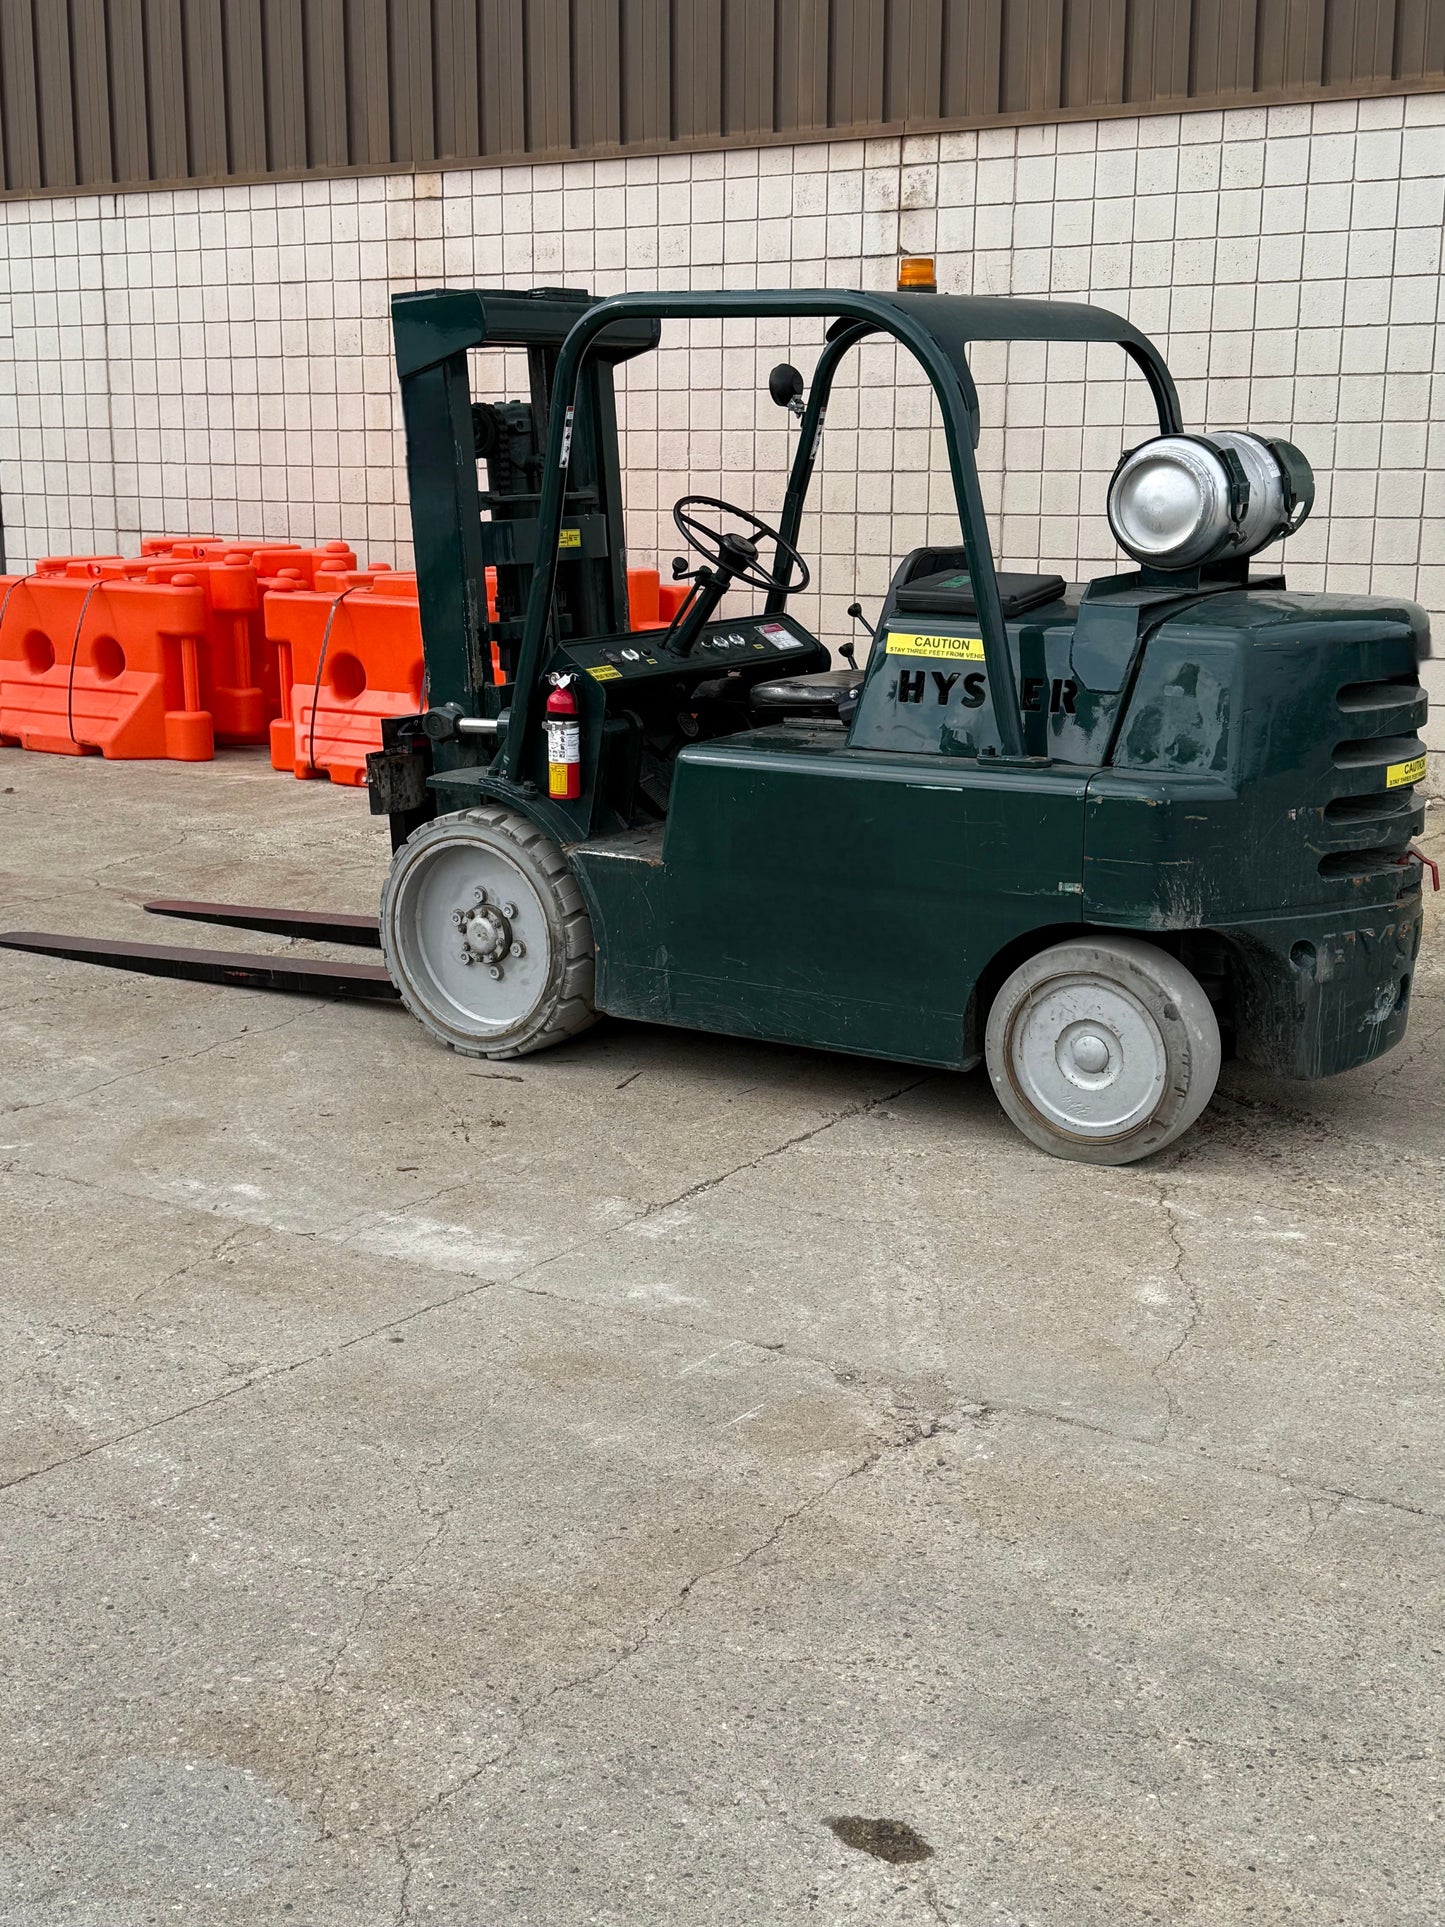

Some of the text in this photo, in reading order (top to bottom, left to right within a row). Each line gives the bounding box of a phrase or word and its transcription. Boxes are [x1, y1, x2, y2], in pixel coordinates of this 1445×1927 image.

[914, 636, 971, 651] CAUTION
[906, 647, 928, 655] THREE
[945, 650, 965, 658] FROM
[965, 652, 985, 660] VEHIC
[899, 669, 1079, 714] HYSER
